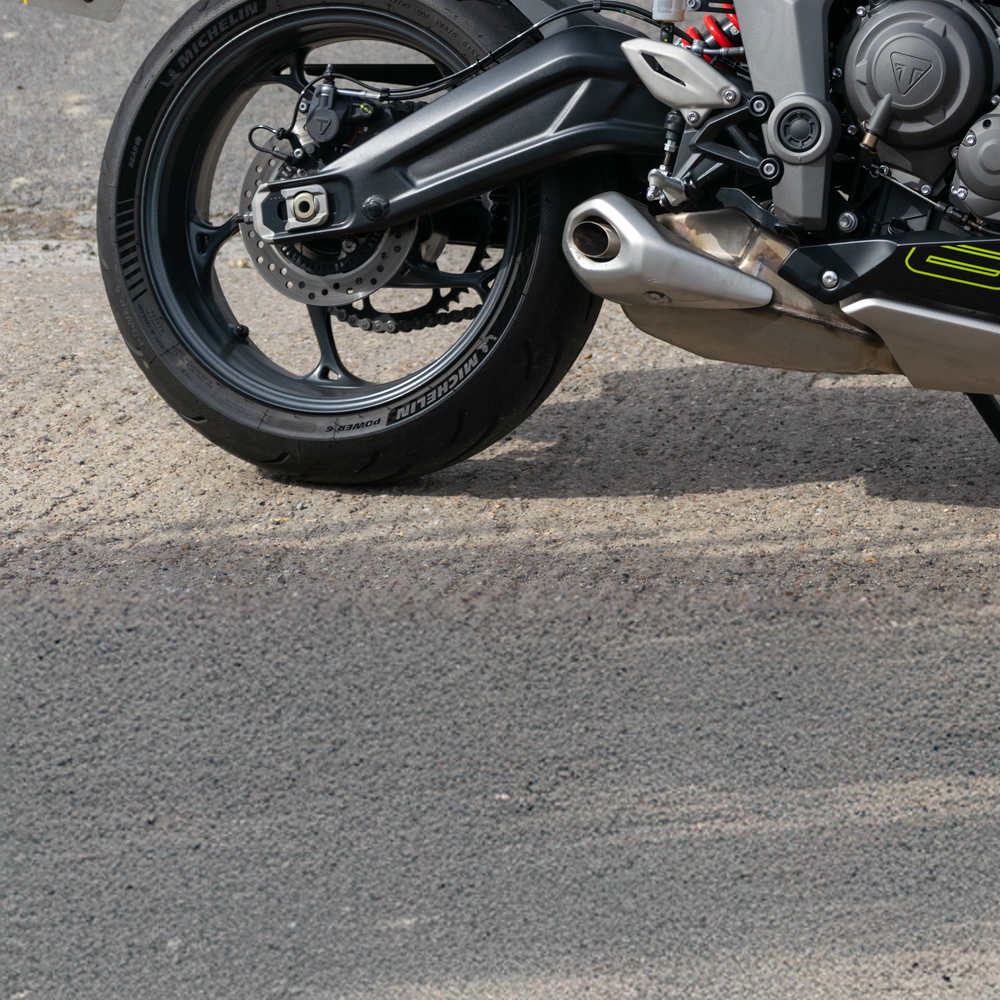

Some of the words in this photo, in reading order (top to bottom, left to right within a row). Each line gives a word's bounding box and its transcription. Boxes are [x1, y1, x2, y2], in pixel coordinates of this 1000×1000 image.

[177, 1, 258, 69] MICHELIN
[128, 143, 140, 169] REAR
[395, 352, 479, 421] MICHELIN
[325, 424, 334, 433] 6
[338, 417, 381, 433] POWER
